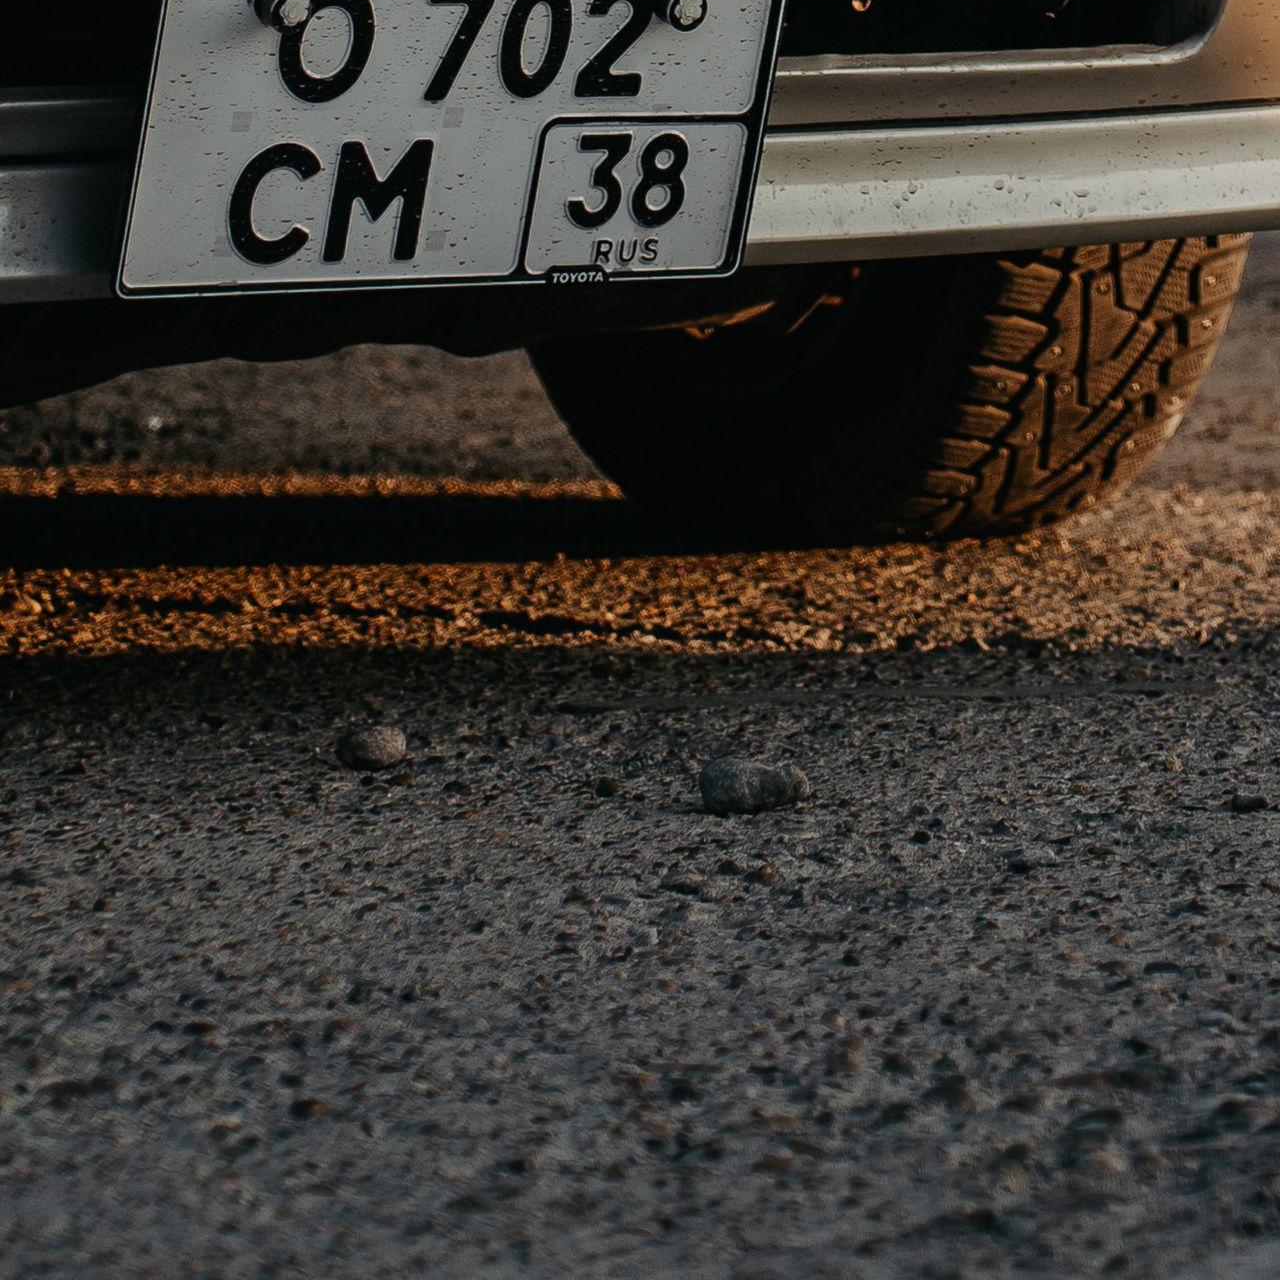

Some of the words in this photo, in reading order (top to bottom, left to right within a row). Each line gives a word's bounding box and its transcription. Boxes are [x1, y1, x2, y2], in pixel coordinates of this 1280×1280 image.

[228, 139, 434, 265] CM
[566, 132, 690, 229] 38
[551, 272, 604, 284] TOYOTA
[592, 239, 659, 266] RUS
